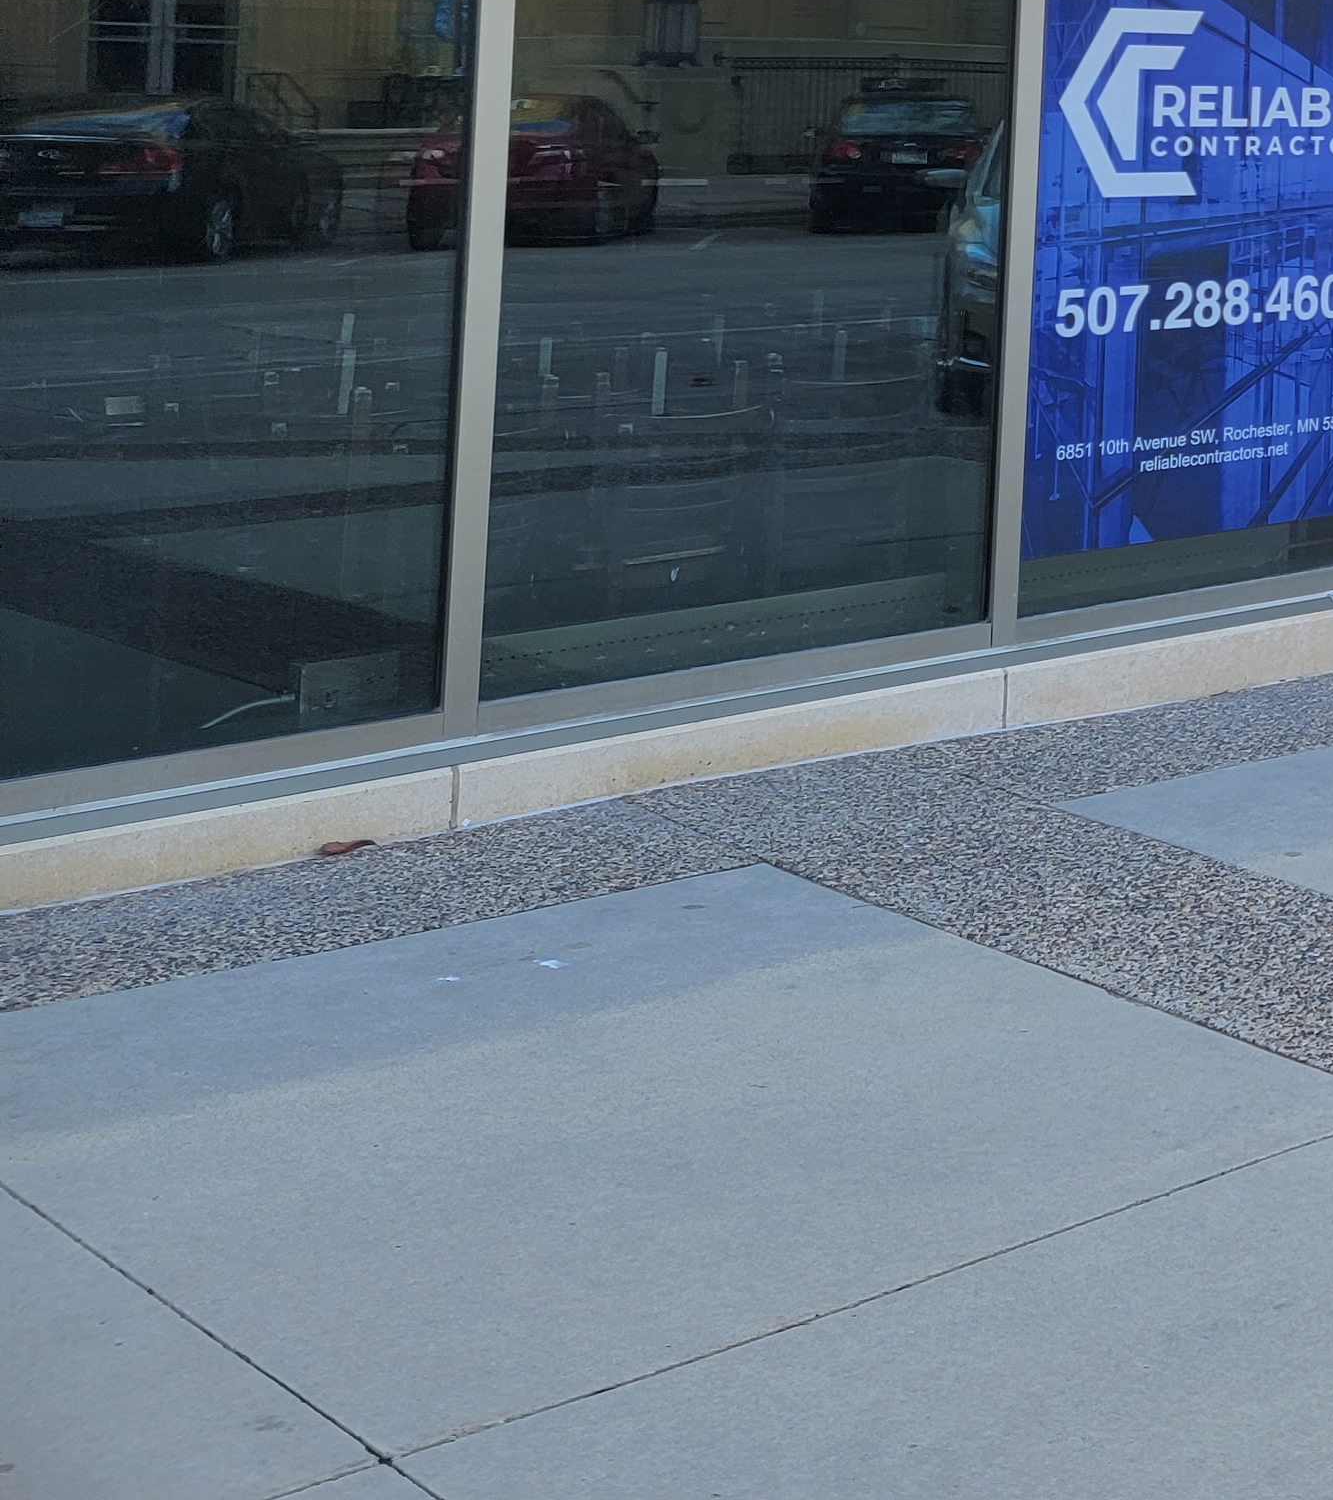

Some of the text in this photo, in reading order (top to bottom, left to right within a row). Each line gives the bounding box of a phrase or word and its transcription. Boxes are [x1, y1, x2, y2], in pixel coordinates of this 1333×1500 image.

[1056, 442, 1092, 461] 6851
[1098, 439, 1129, 456] 10th
[1133, 435, 1187, 452] Avenue
[1190, 428, 1219, 445] SW,
[1223, 422, 1294, 442] Rochester,
[1297, 417, 1319, 434] MN
[1139, 441, 1289, 473] reliablecontractors.net
